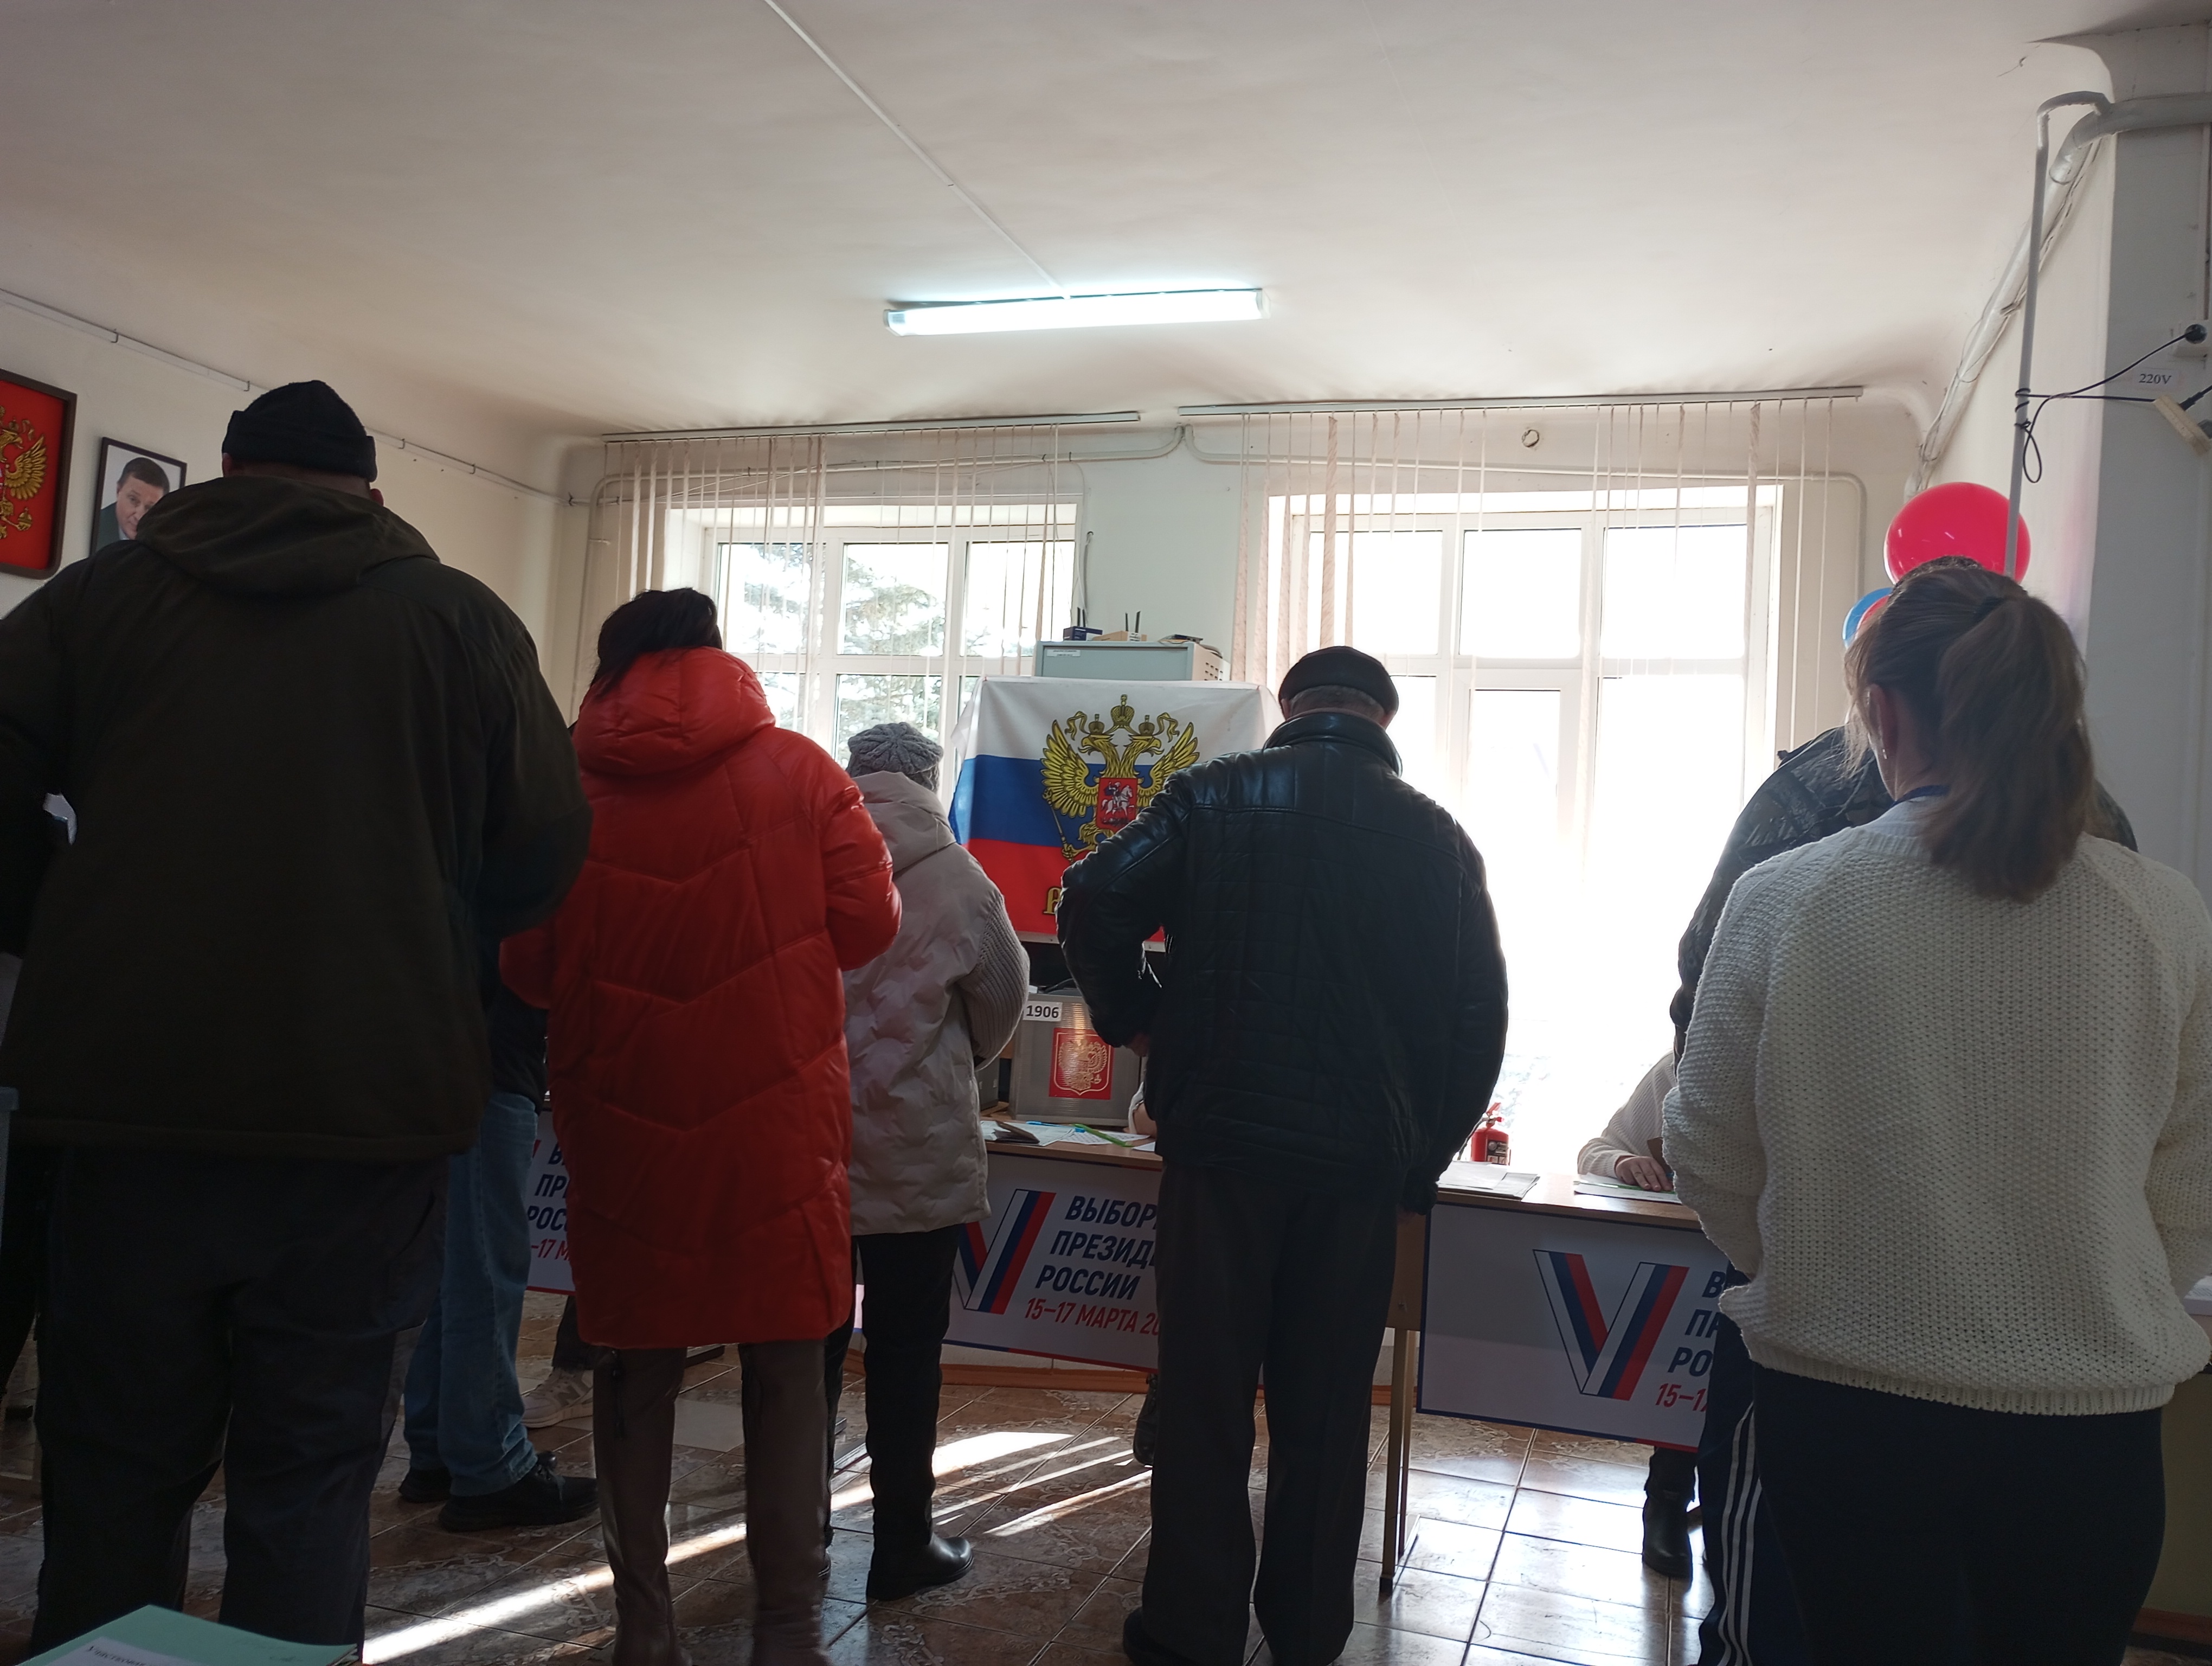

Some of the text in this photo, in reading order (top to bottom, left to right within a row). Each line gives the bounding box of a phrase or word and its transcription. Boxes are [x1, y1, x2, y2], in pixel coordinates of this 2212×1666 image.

[2138, 373, 2172, 385] 220V
[1026, 1005, 1059, 1018] 1906
[527, 1205, 568, 1232] РОС
[1064, 1195, 1158, 1230] ВЫБОР
[530, 1238, 557, 1259] –17
[1050, 1230, 1155, 1270] ПРЕЗИД
[1034, 1264, 1142, 1300] РОССИИ
[1025, 1297, 1077, 1324] 15–17
[1074, 1304, 1139, 1333] МАРТА
[1655, 1382, 1708, 1412] 15–1
